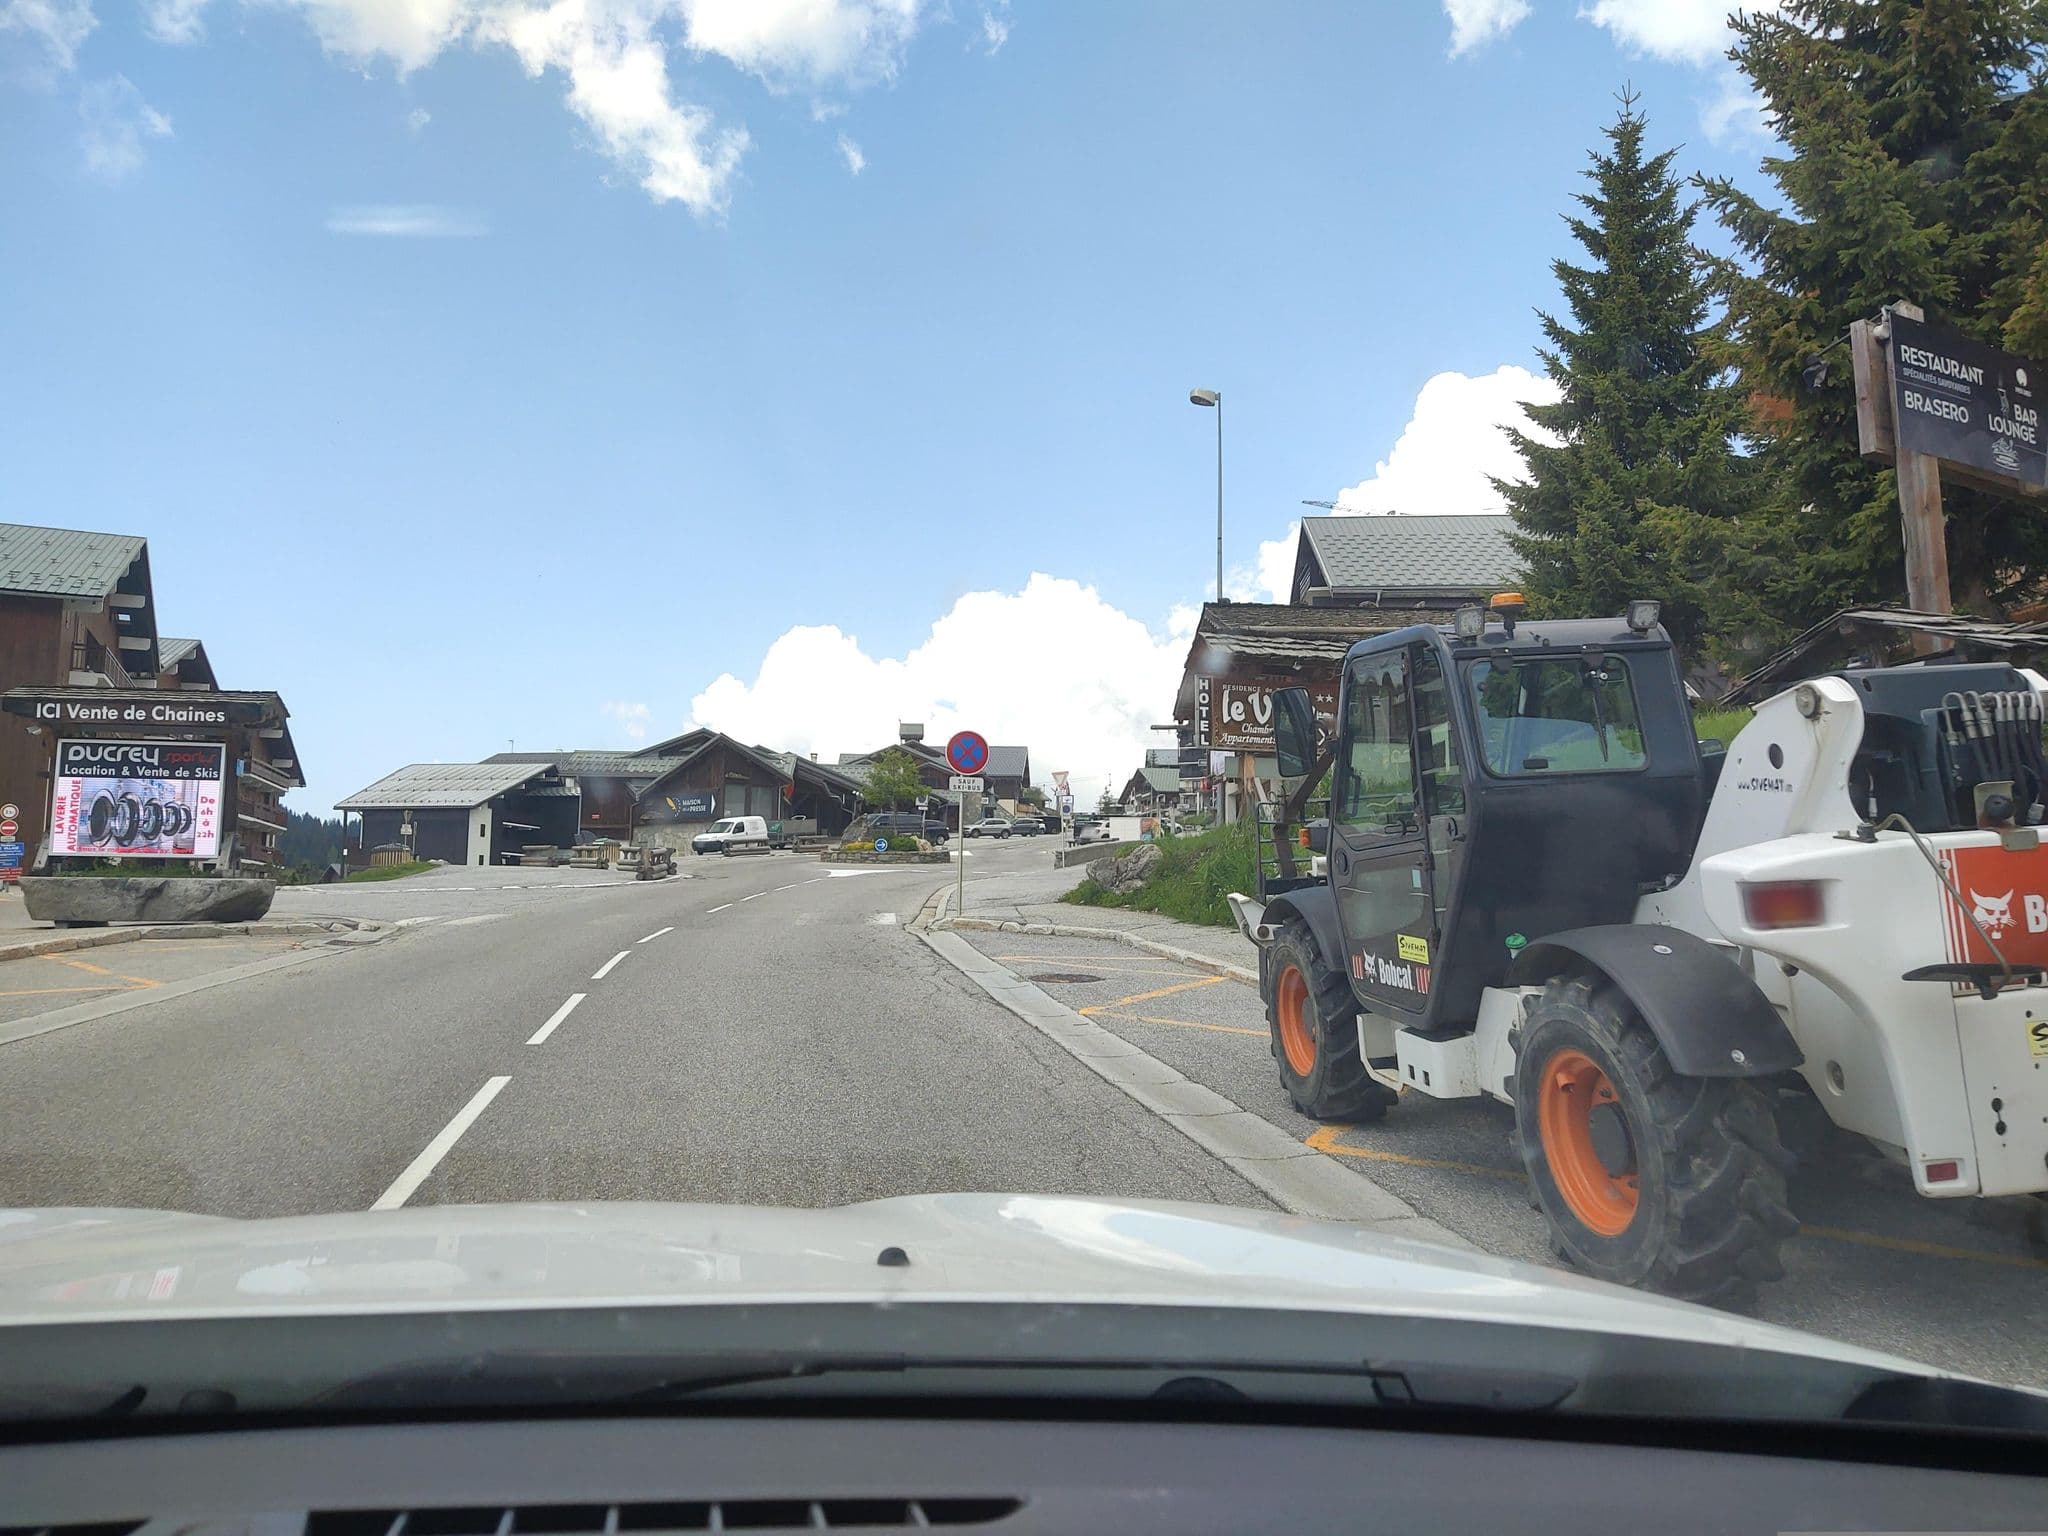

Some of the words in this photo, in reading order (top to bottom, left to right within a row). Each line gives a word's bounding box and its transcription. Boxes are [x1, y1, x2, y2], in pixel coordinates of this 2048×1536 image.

[1901, 345, 1983, 386] RESTAURANT
[1904, 390, 1969, 423] BRASERO
[2013, 404, 2038, 427] BAR
[1988, 413, 2037, 444] LOUNGE
[36, 703, 61, 719] ICI
[67, 704, 119, 720] Vente
[123, 704, 146, 721] de
[152, 705, 226, 722] Chaines
[1199, 679, 1210, 746] HOTEL
[1222, 690, 1246, 723] le
[1247, 691, 1273, 725] V
[1241, 722, 1274, 734] Chambr
[64, 764, 116, 776] Location
[121, 766, 130, 776] &
[136, 765, 171, 777] Vente
[175, 766, 190, 778] de
[194, 767, 219, 778] Skis
[55, 795, 67, 834] LAVERIE
[67, 779, 81, 852] AUTOMATIQUE
[200, 796, 215, 804] De
[197, 830, 214, 838] 22h
[1378, 958, 1413, 991] Bobcat
